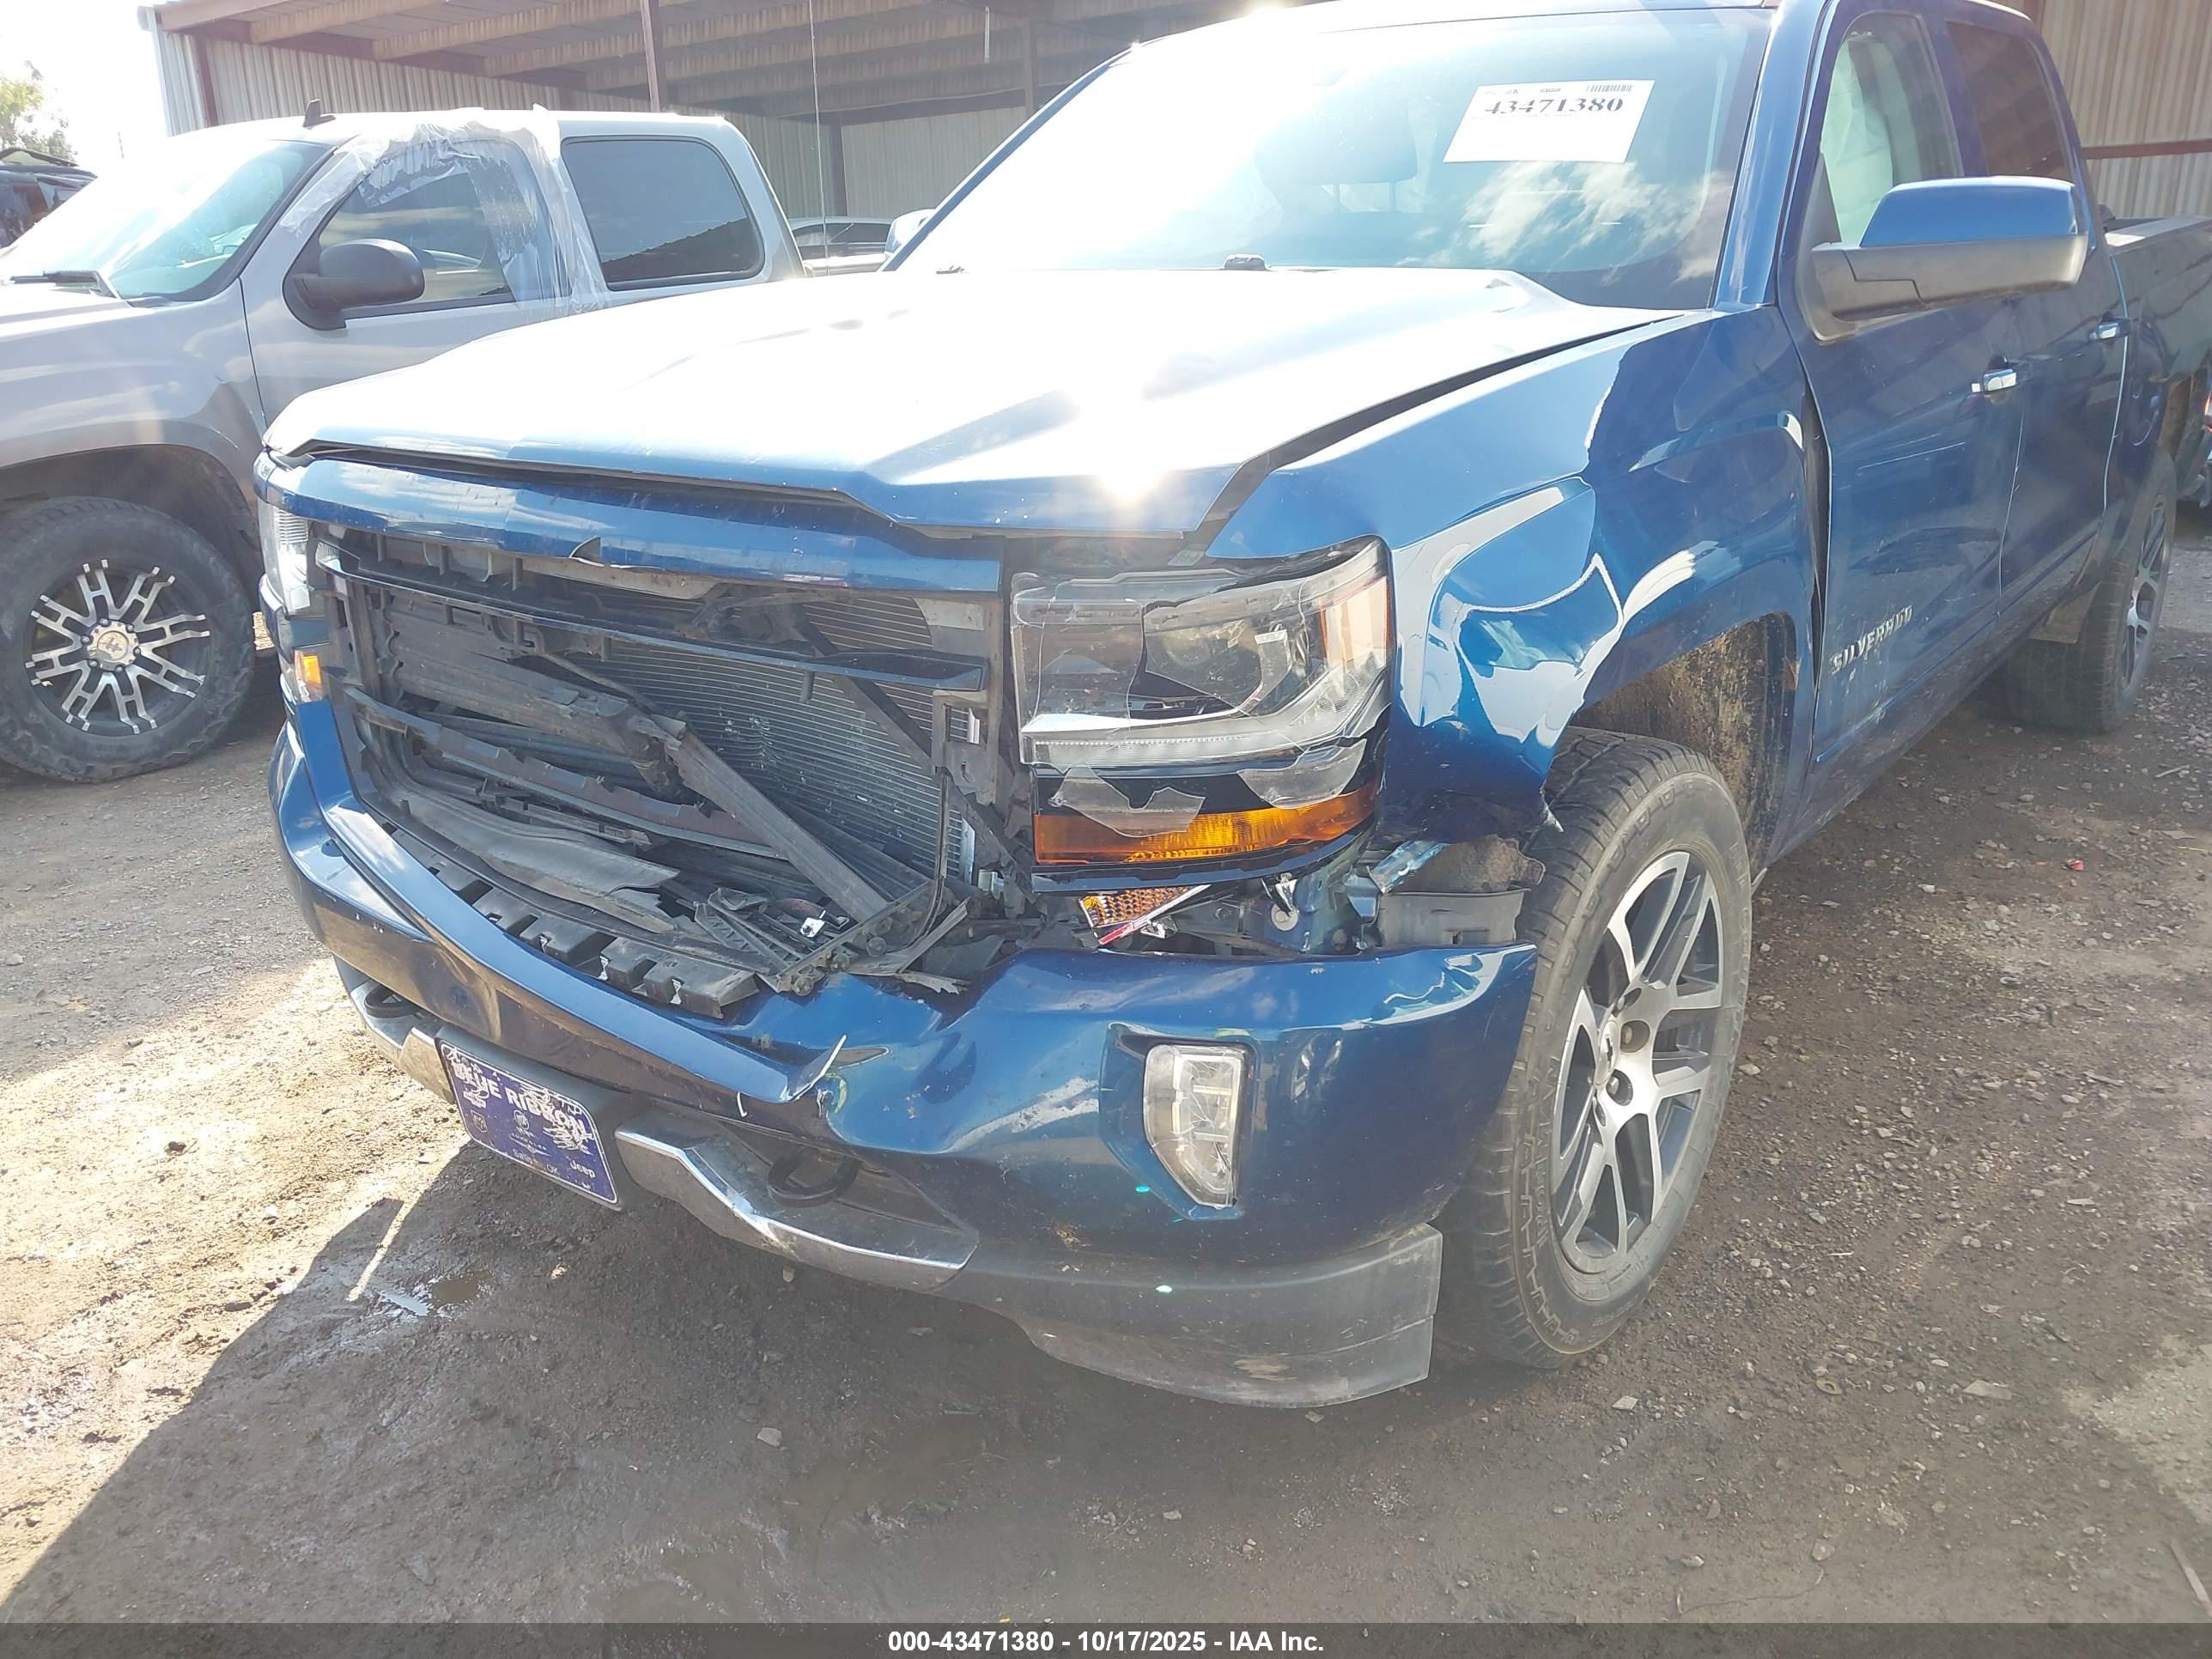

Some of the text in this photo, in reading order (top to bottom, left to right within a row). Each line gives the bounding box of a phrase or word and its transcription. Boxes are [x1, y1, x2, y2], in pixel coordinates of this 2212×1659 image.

[1485, 98, 1624, 114] 43471380
[1829, 605, 1913, 675] SILVERADO
[505, 1086, 589, 1143] RIBBON
[569, 1159, 596, 1179] Jeep
